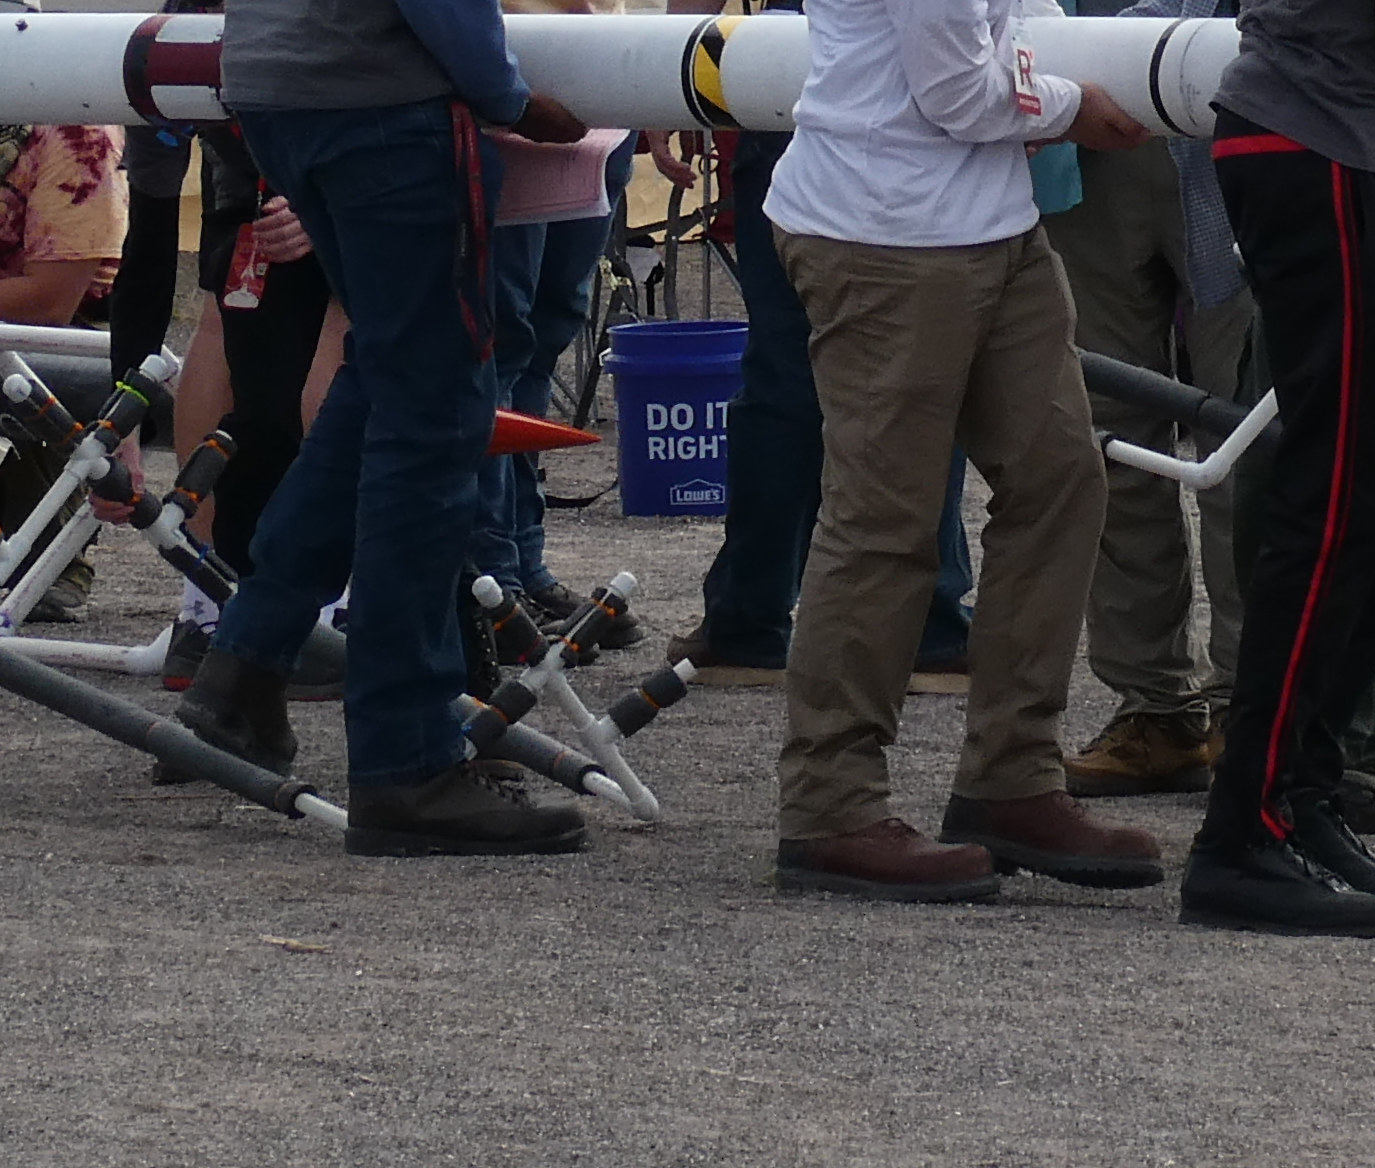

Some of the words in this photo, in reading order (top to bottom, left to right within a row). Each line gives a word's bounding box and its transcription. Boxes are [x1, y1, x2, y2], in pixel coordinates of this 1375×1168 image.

[1017, 48, 1033, 89] R
[647, 403, 694, 431] DO
[706, 401, 730, 430] IT
